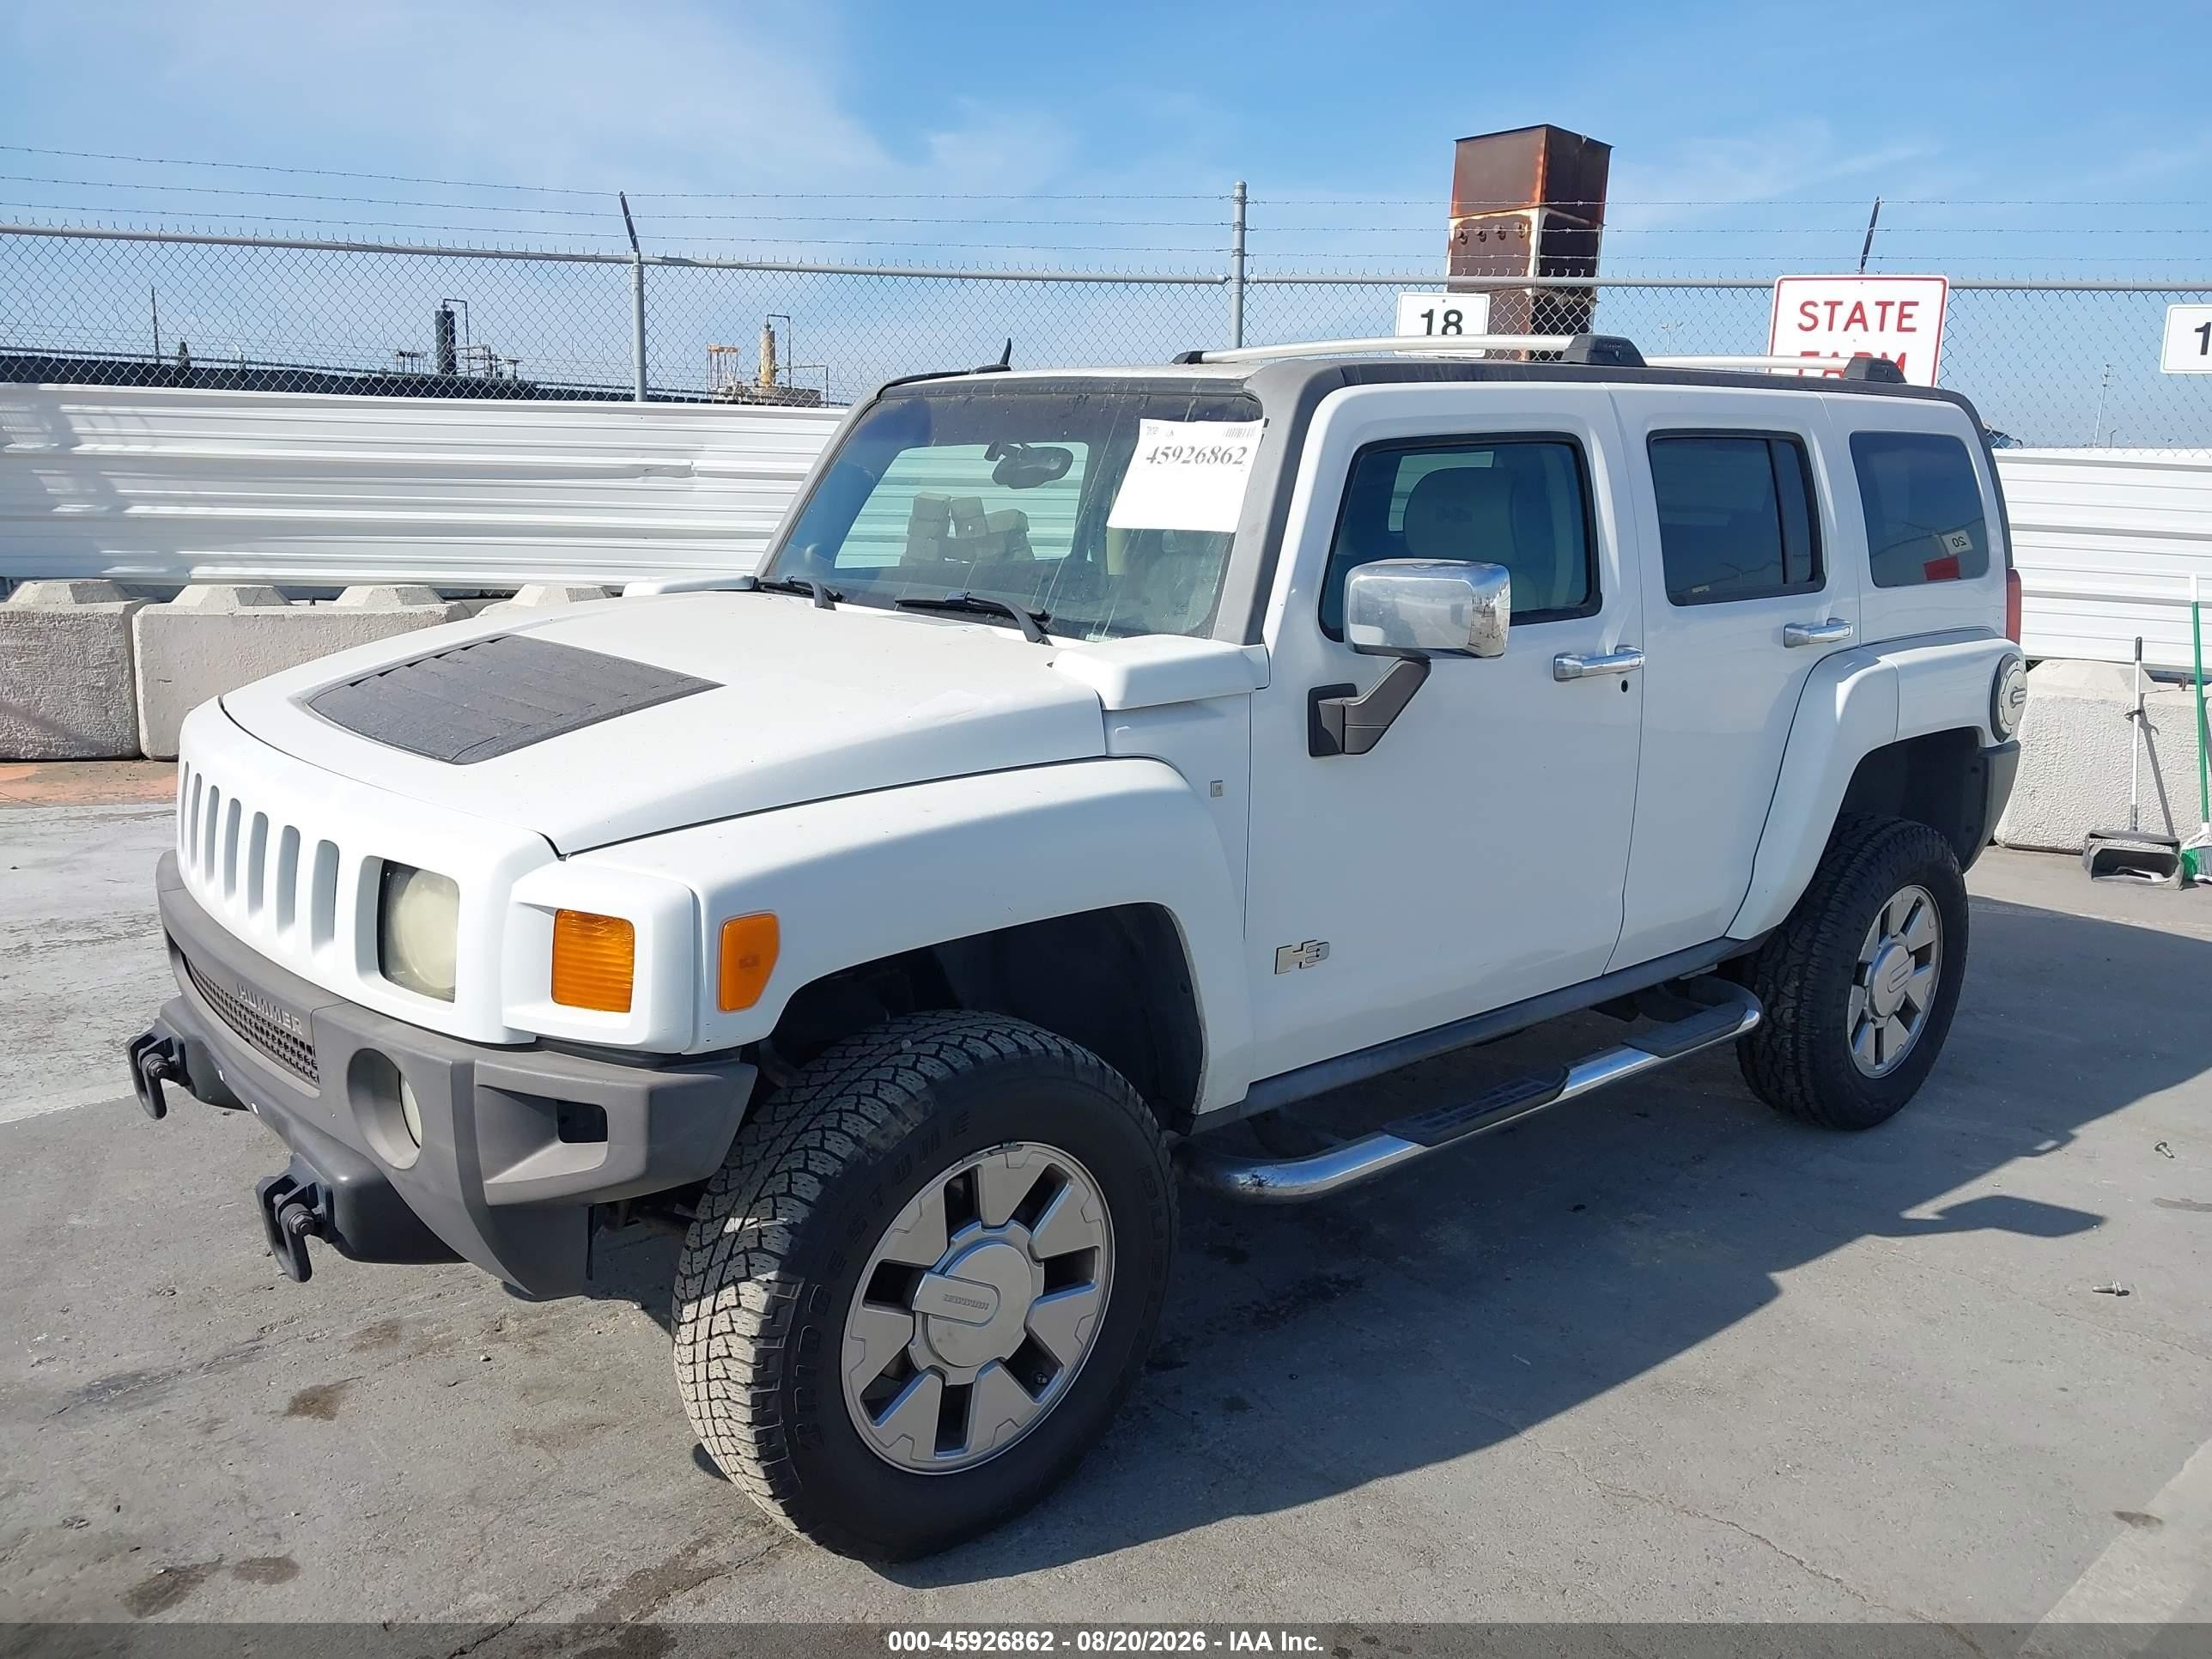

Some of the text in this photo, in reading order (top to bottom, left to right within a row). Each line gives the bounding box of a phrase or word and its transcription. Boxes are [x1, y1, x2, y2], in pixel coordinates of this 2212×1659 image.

[1420, 308, 1463, 336] 18
[1797, 301, 1920, 332] STATE
[1146, 445, 1248, 465] 45926862
[1274, 939, 1330, 975] H3
[236, 982, 303, 1036] HUMMER
